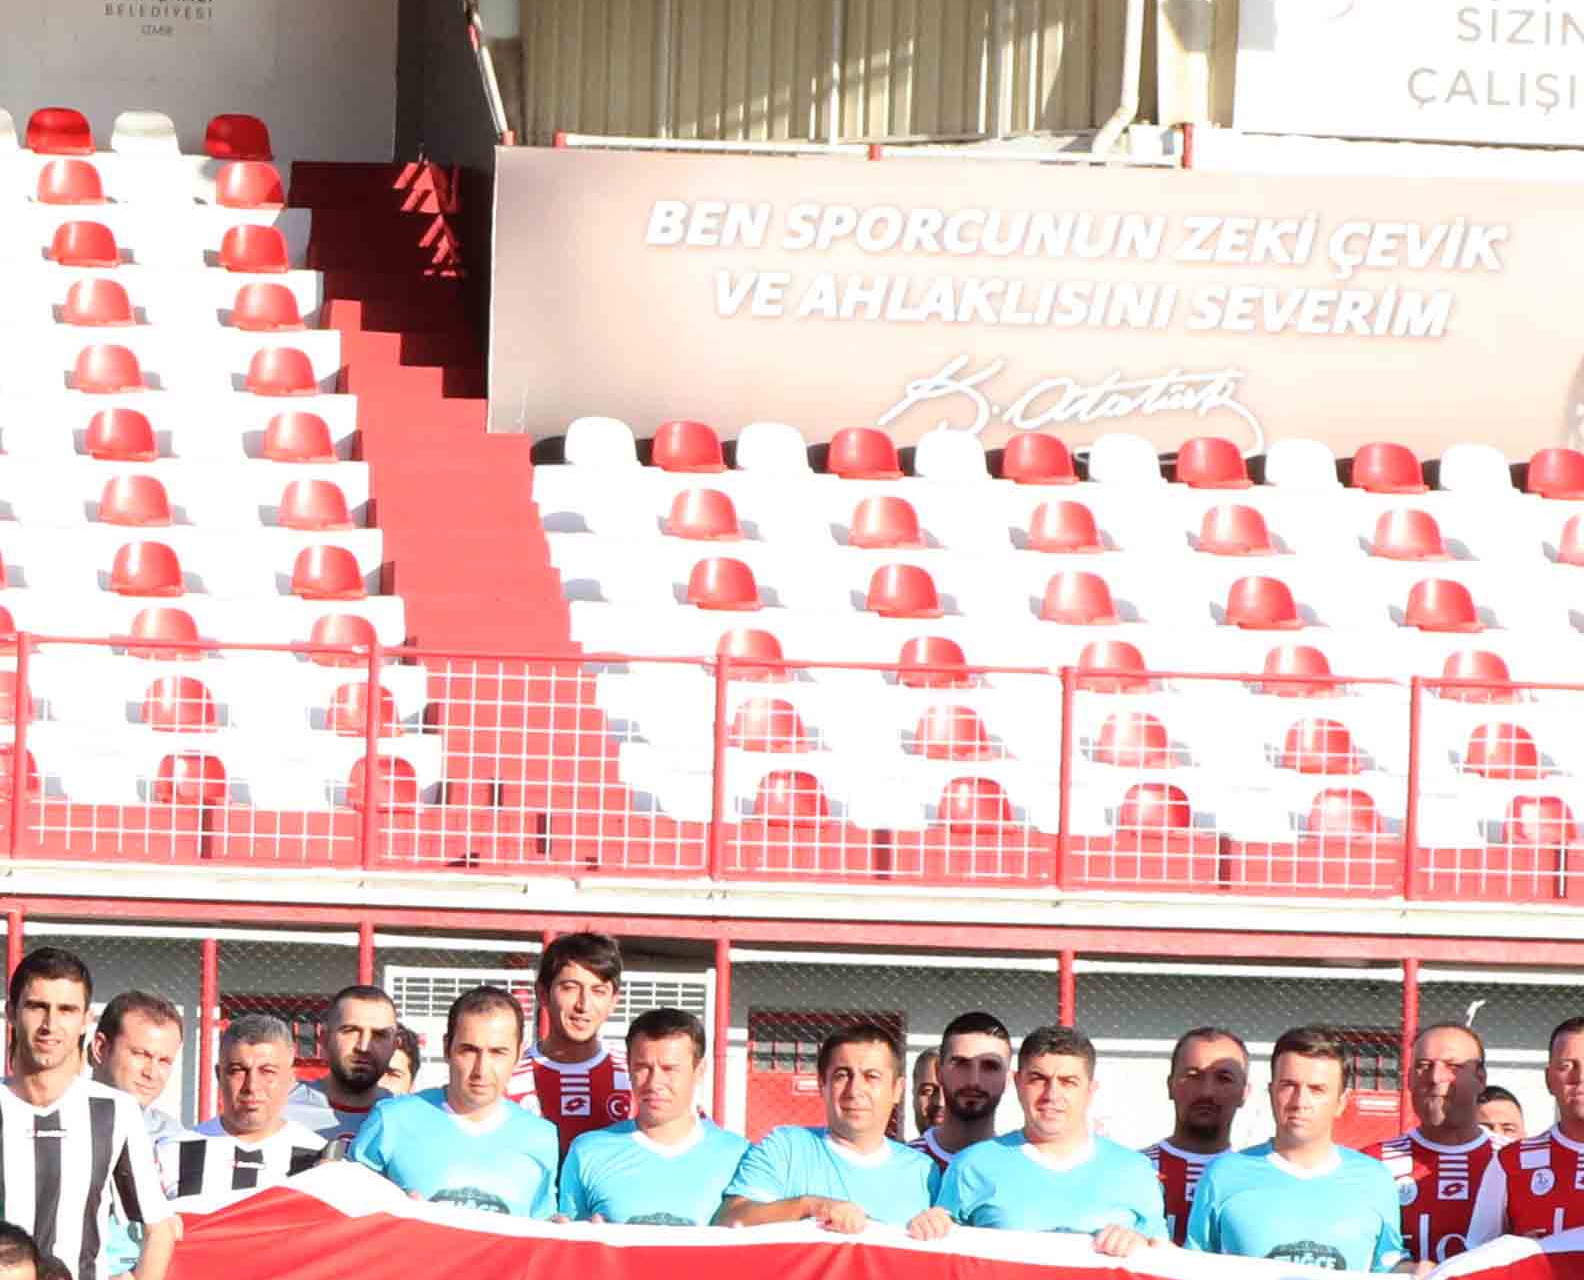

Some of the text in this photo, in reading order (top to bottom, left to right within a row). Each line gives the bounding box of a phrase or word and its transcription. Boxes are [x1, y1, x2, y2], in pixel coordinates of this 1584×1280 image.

[646, 200, 1509, 280] BEN SPORCUNUN ZEKİ ÇEVİK
[714, 270, 1454, 338] VE AHLAKLISINI SEVERİM
